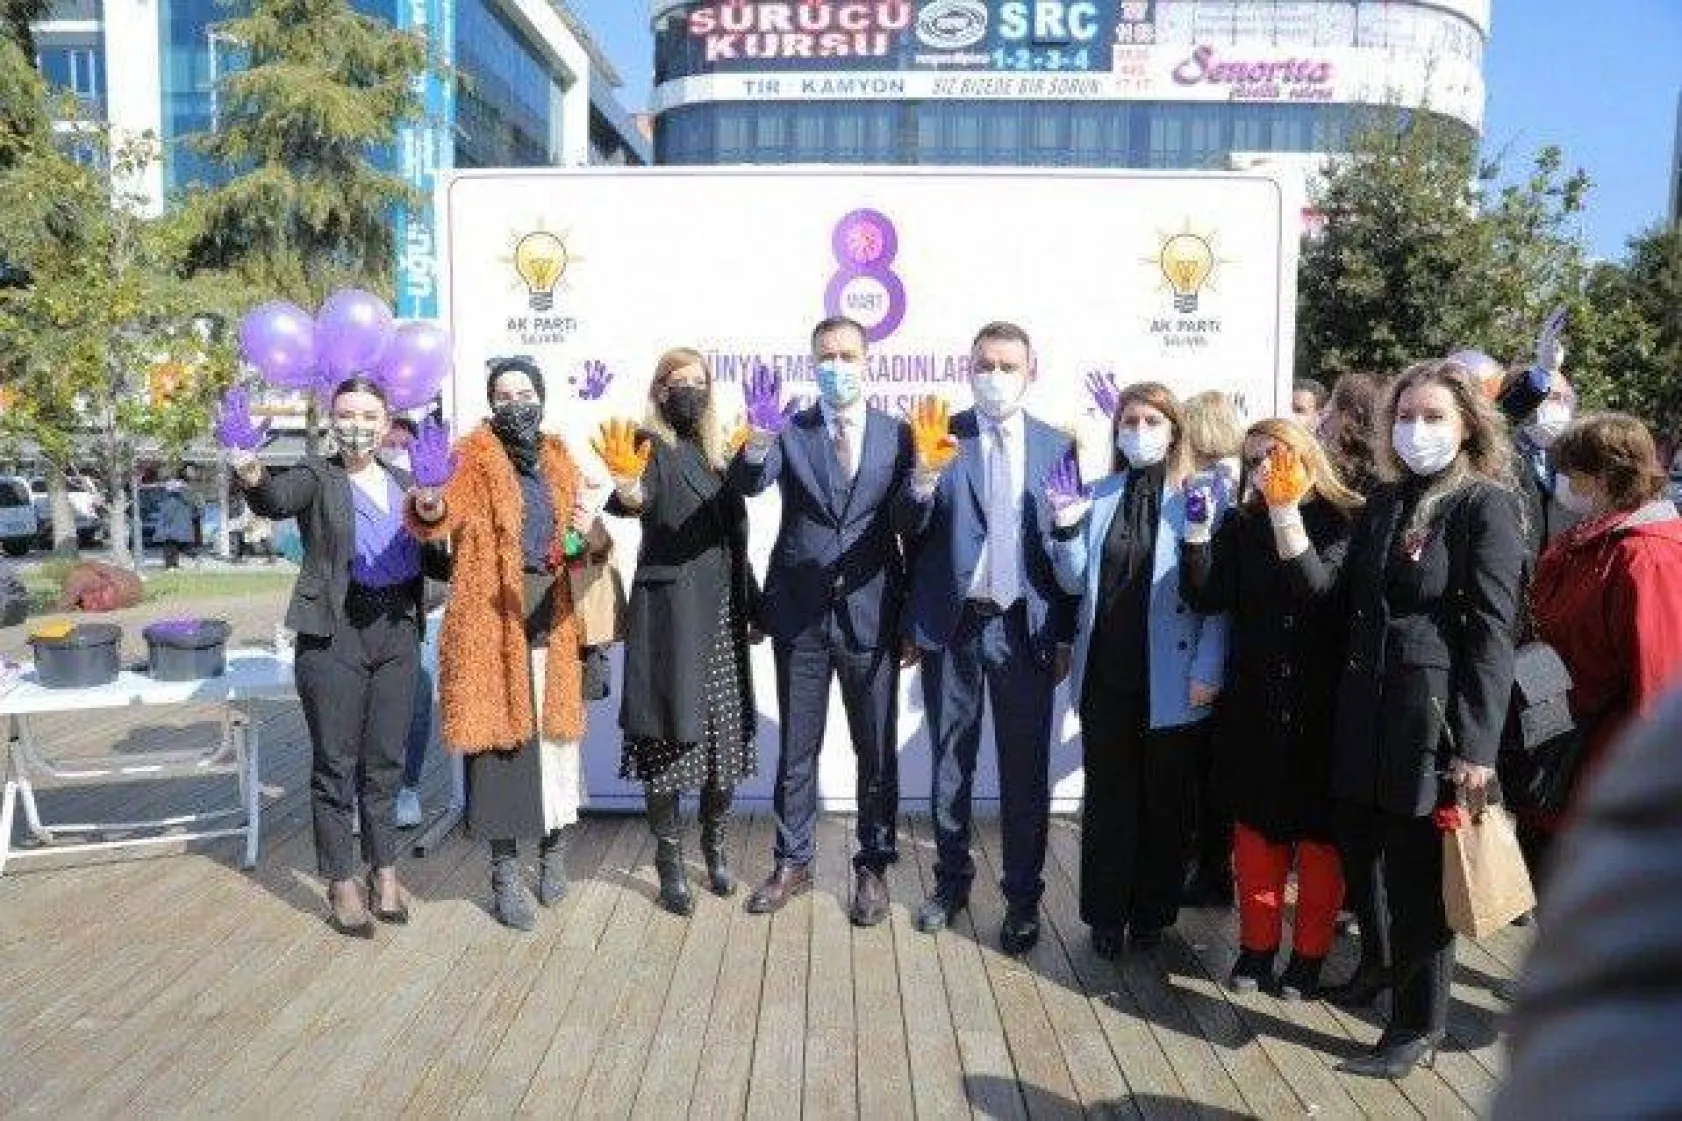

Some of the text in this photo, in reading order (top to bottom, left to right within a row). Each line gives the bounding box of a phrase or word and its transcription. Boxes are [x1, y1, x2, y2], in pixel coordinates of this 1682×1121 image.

[999, 1, 1099, 39] SRC
[705, 33, 889, 61] KURSU
[802, 78, 905, 94] KAMYON
[824, 208, 906, 343] 8
[507, 317, 527, 332] AK
[1150, 319, 1171, 333] AK
